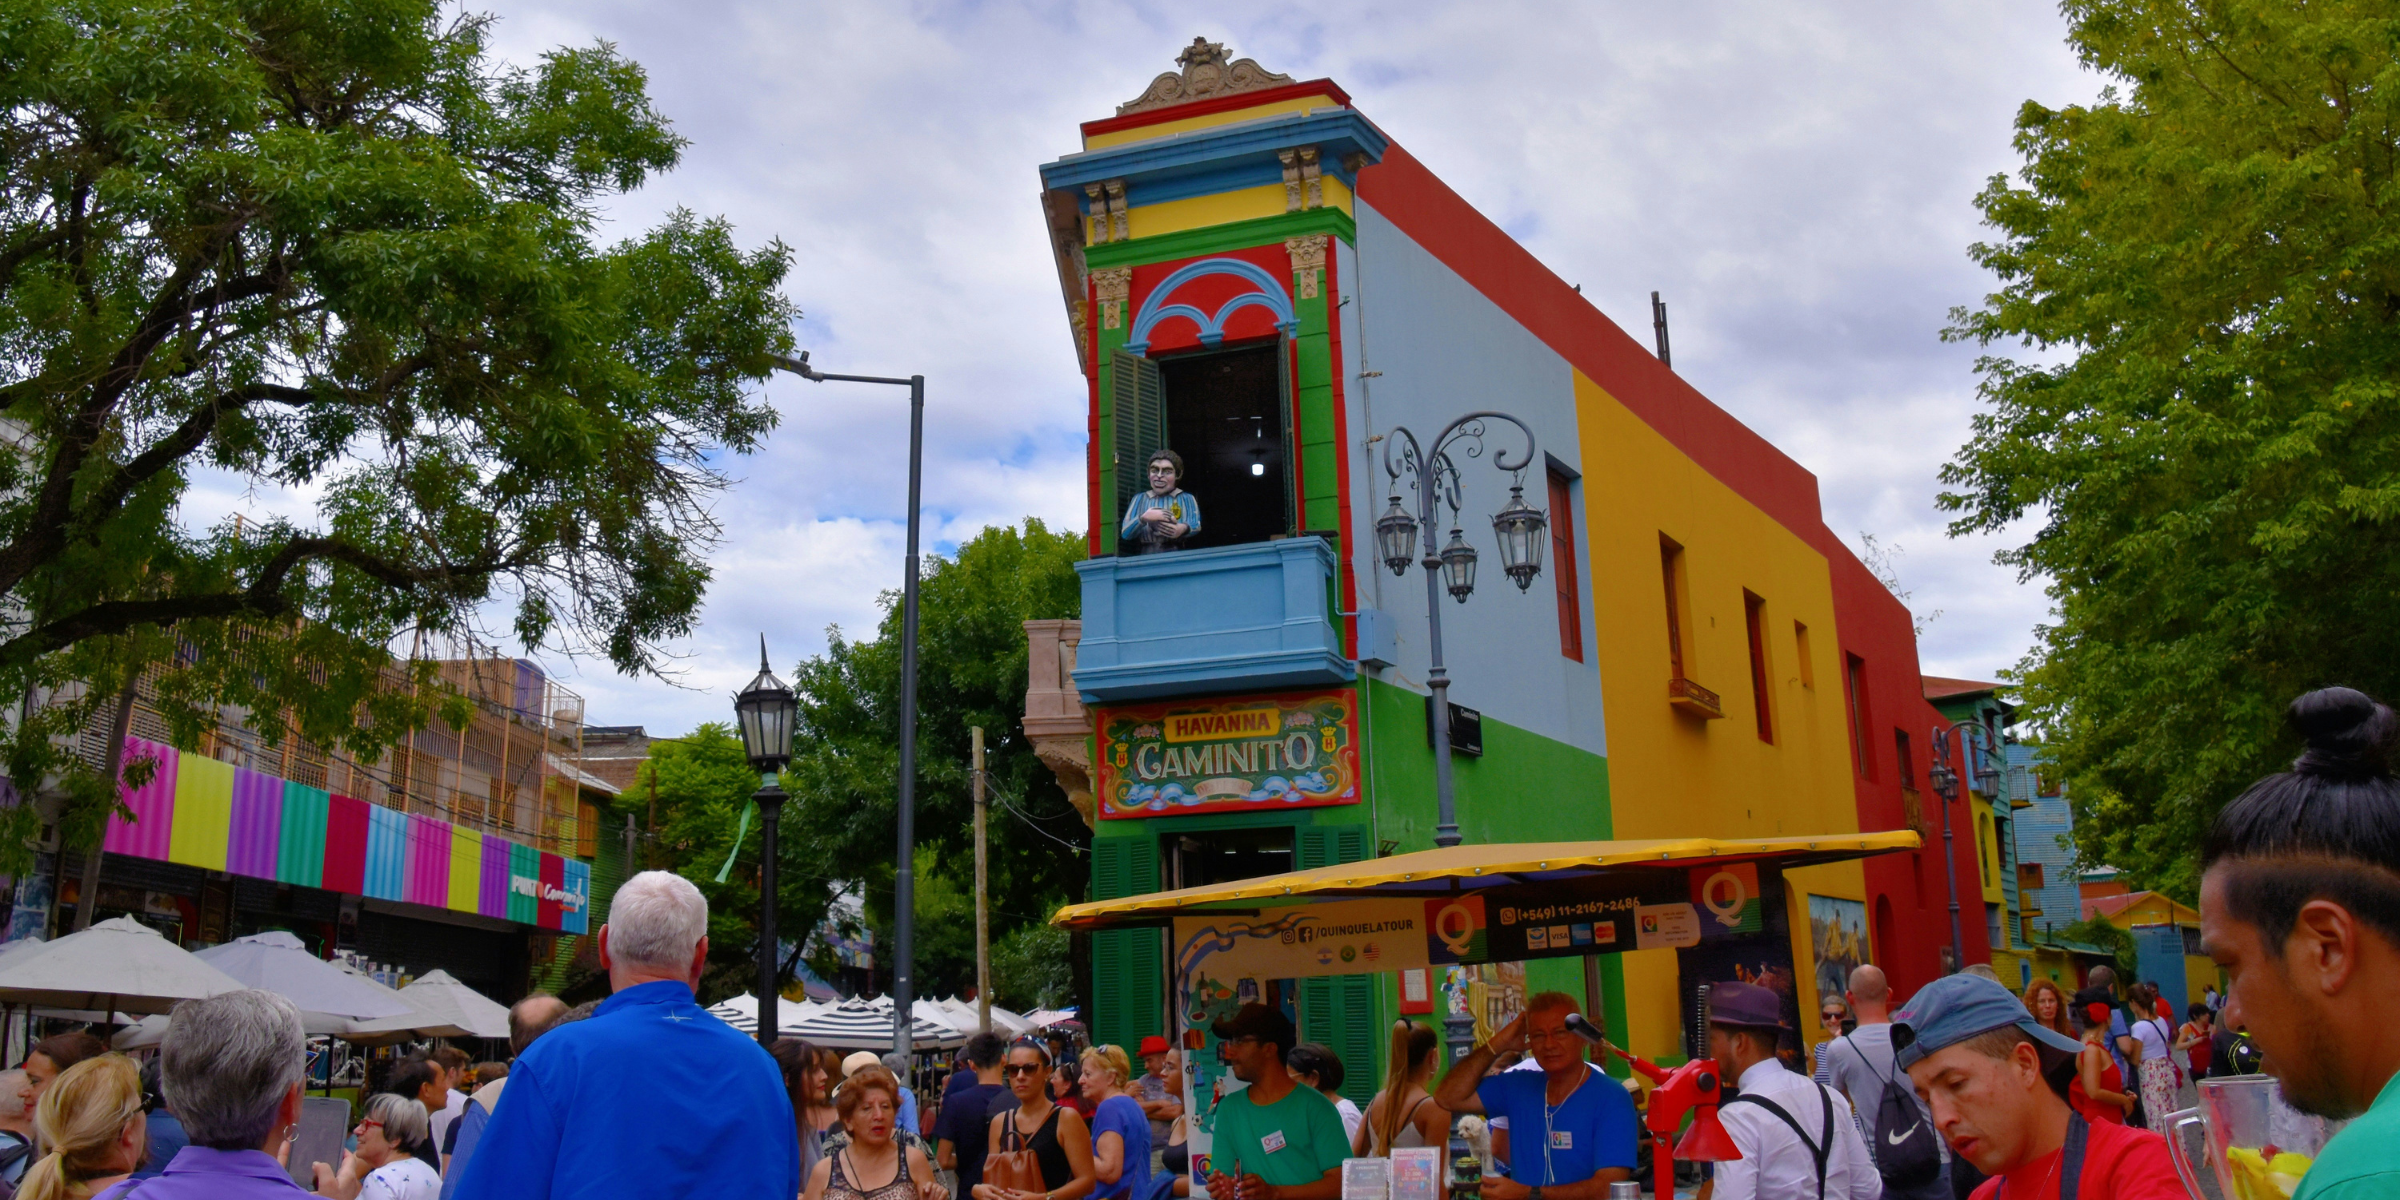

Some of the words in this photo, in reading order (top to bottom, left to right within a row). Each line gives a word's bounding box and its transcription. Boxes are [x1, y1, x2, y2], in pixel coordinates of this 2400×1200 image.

[1176, 712, 1271, 737] HAVANNA
[1135, 731, 1316, 780] CAMINITO
[1325, 738, 1333, 750] H
[1118, 753, 1126, 765] H
[511, 874, 544, 899] PUNTO
[544, 878, 586, 913] Caminito
[1702, 871, 1747, 927] Q
[1517, 904, 1556, 921] (+549)
[1558, 896, 1640, 916] 11-2167-2486
[1316, 919, 1414, 939] /QUINQUELATOUR
[1435, 903, 1474, 956] Q
[1551, 932, 1569, 940] VISA
